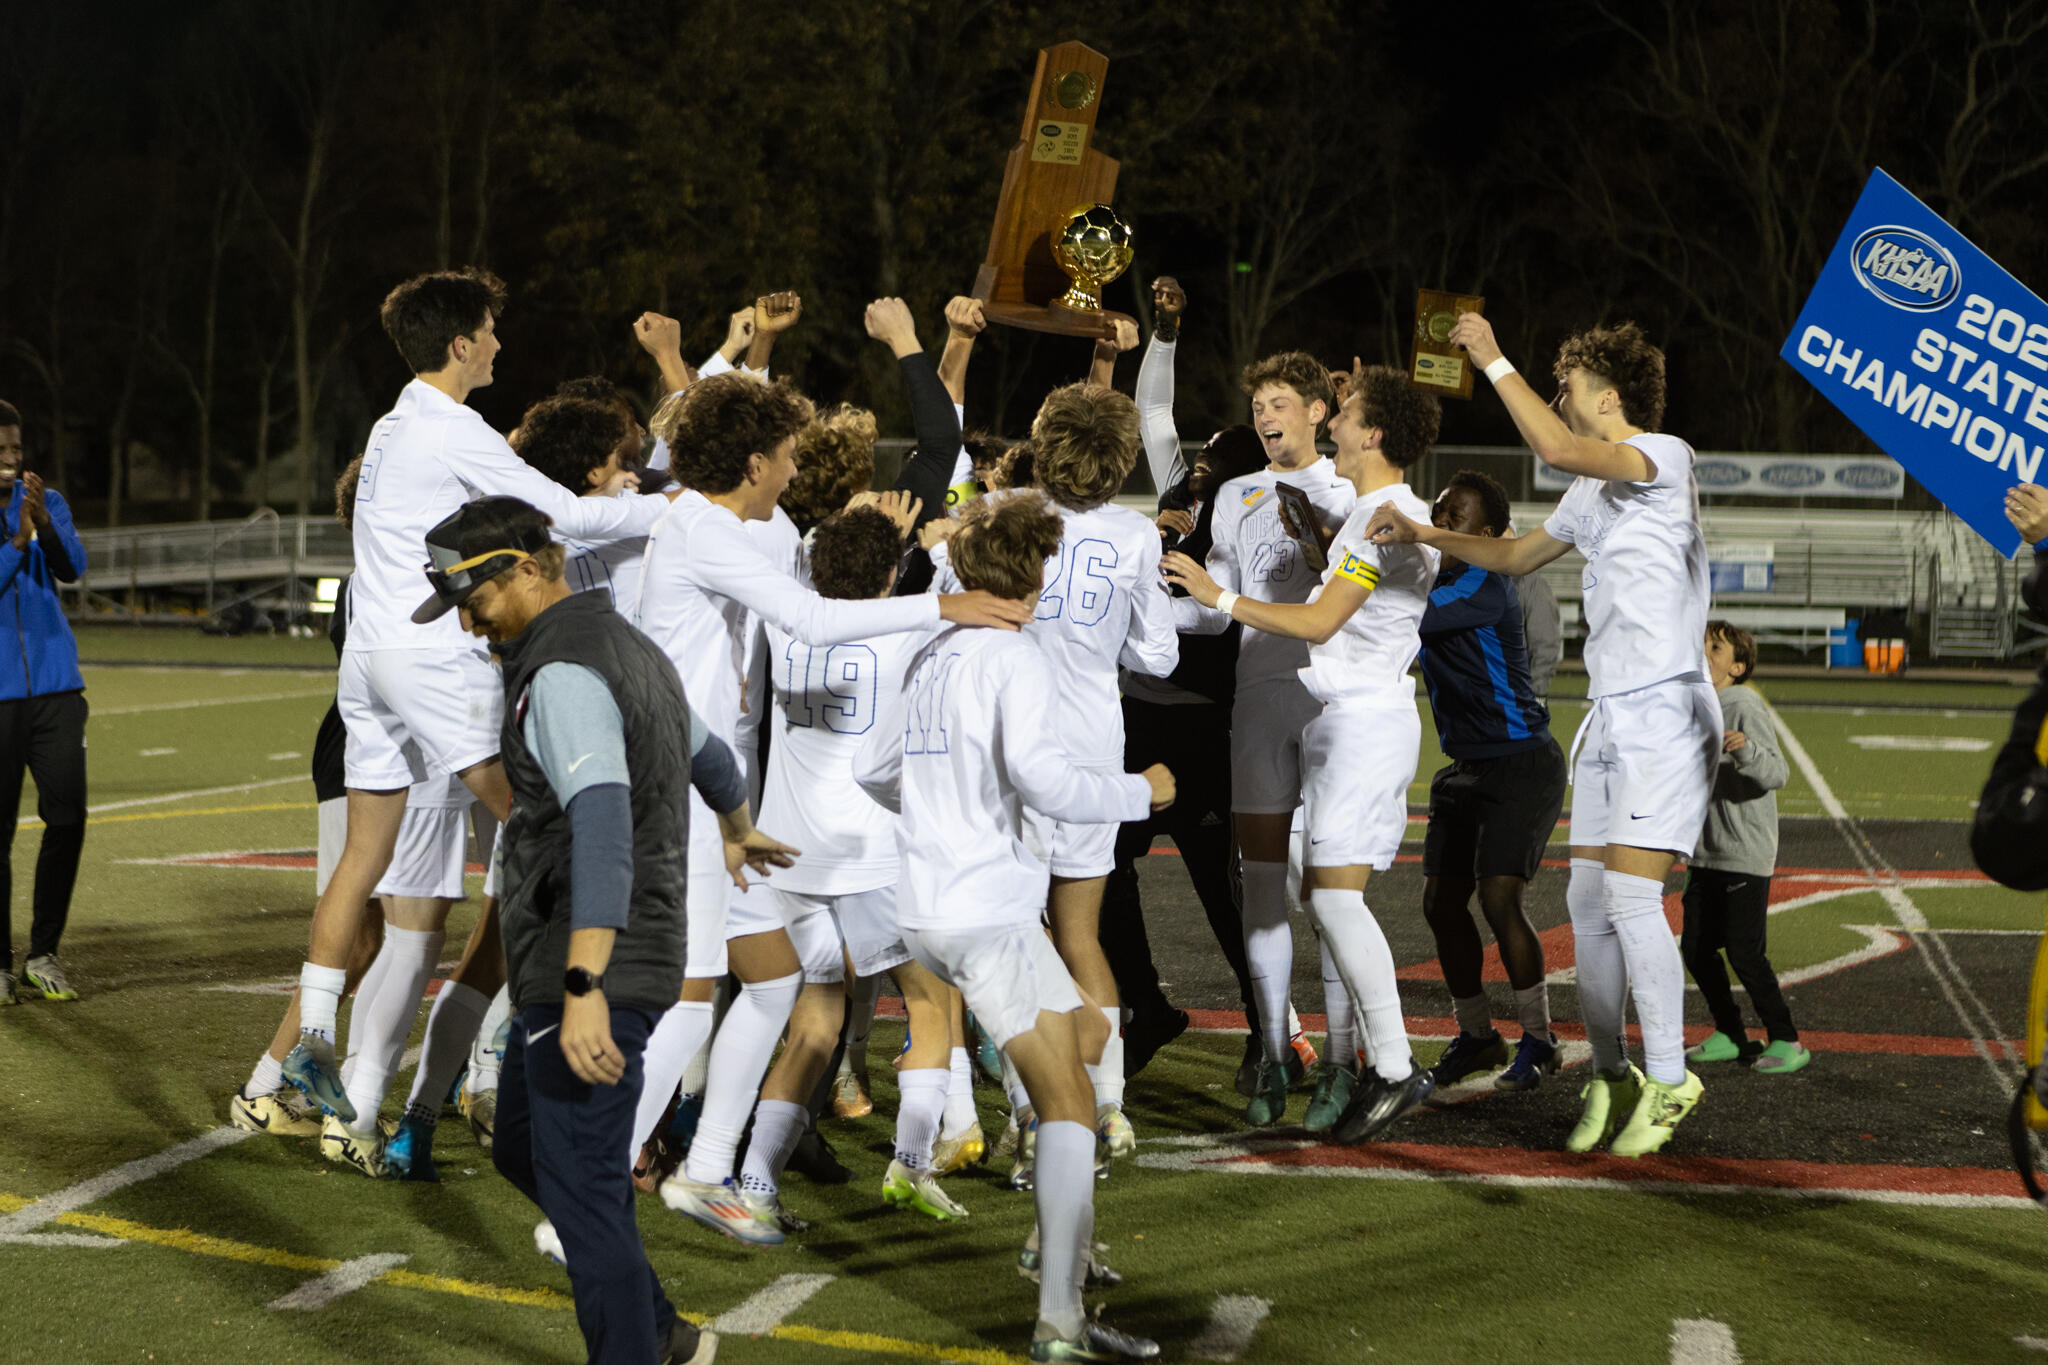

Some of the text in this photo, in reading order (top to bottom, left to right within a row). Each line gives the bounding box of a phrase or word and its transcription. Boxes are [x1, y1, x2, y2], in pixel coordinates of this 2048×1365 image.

[1862, 238, 1949, 299] KHSAA
[1798, 325, 2045, 484] CHAMPION
[1911, 328, 2048, 433] STATE
[1253, 541, 1296, 583] 23
[1344, 554, 1359, 573] C
[785, 639, 877, 735] 19
[905, 653, 961, 754] 11
